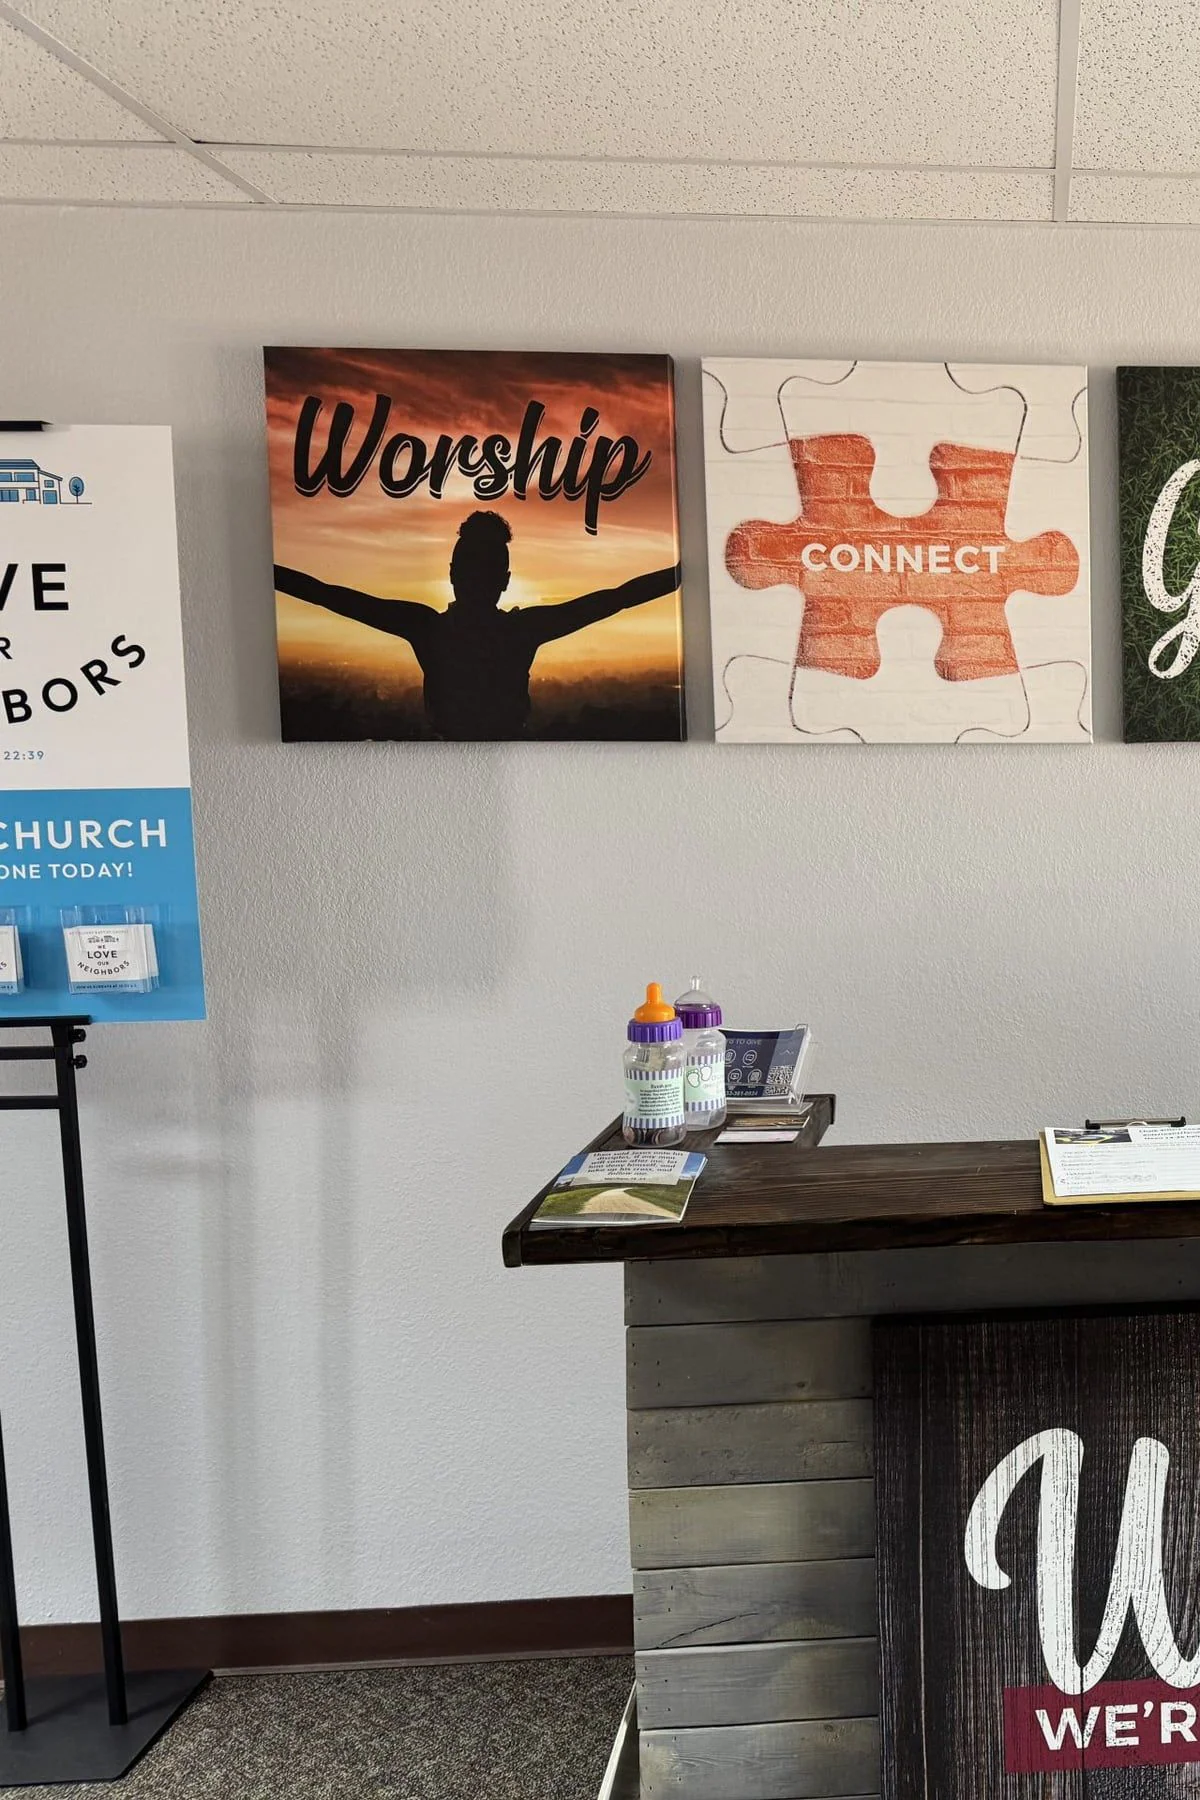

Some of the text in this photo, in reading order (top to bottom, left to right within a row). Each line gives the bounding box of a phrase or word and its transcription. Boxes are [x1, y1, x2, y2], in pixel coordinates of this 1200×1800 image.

[293, 393, 652, 536] Worship
[801, 543, 1006, 574] CONNECT
[2, 634, 146, 724] BORS
[4, 750, 45, 761] 22:39
[48, 861, 133, 879] TODAY!
[87, 950, 118, 959] LOVE
[77, 960, 130, 975] NEIGHBORS
